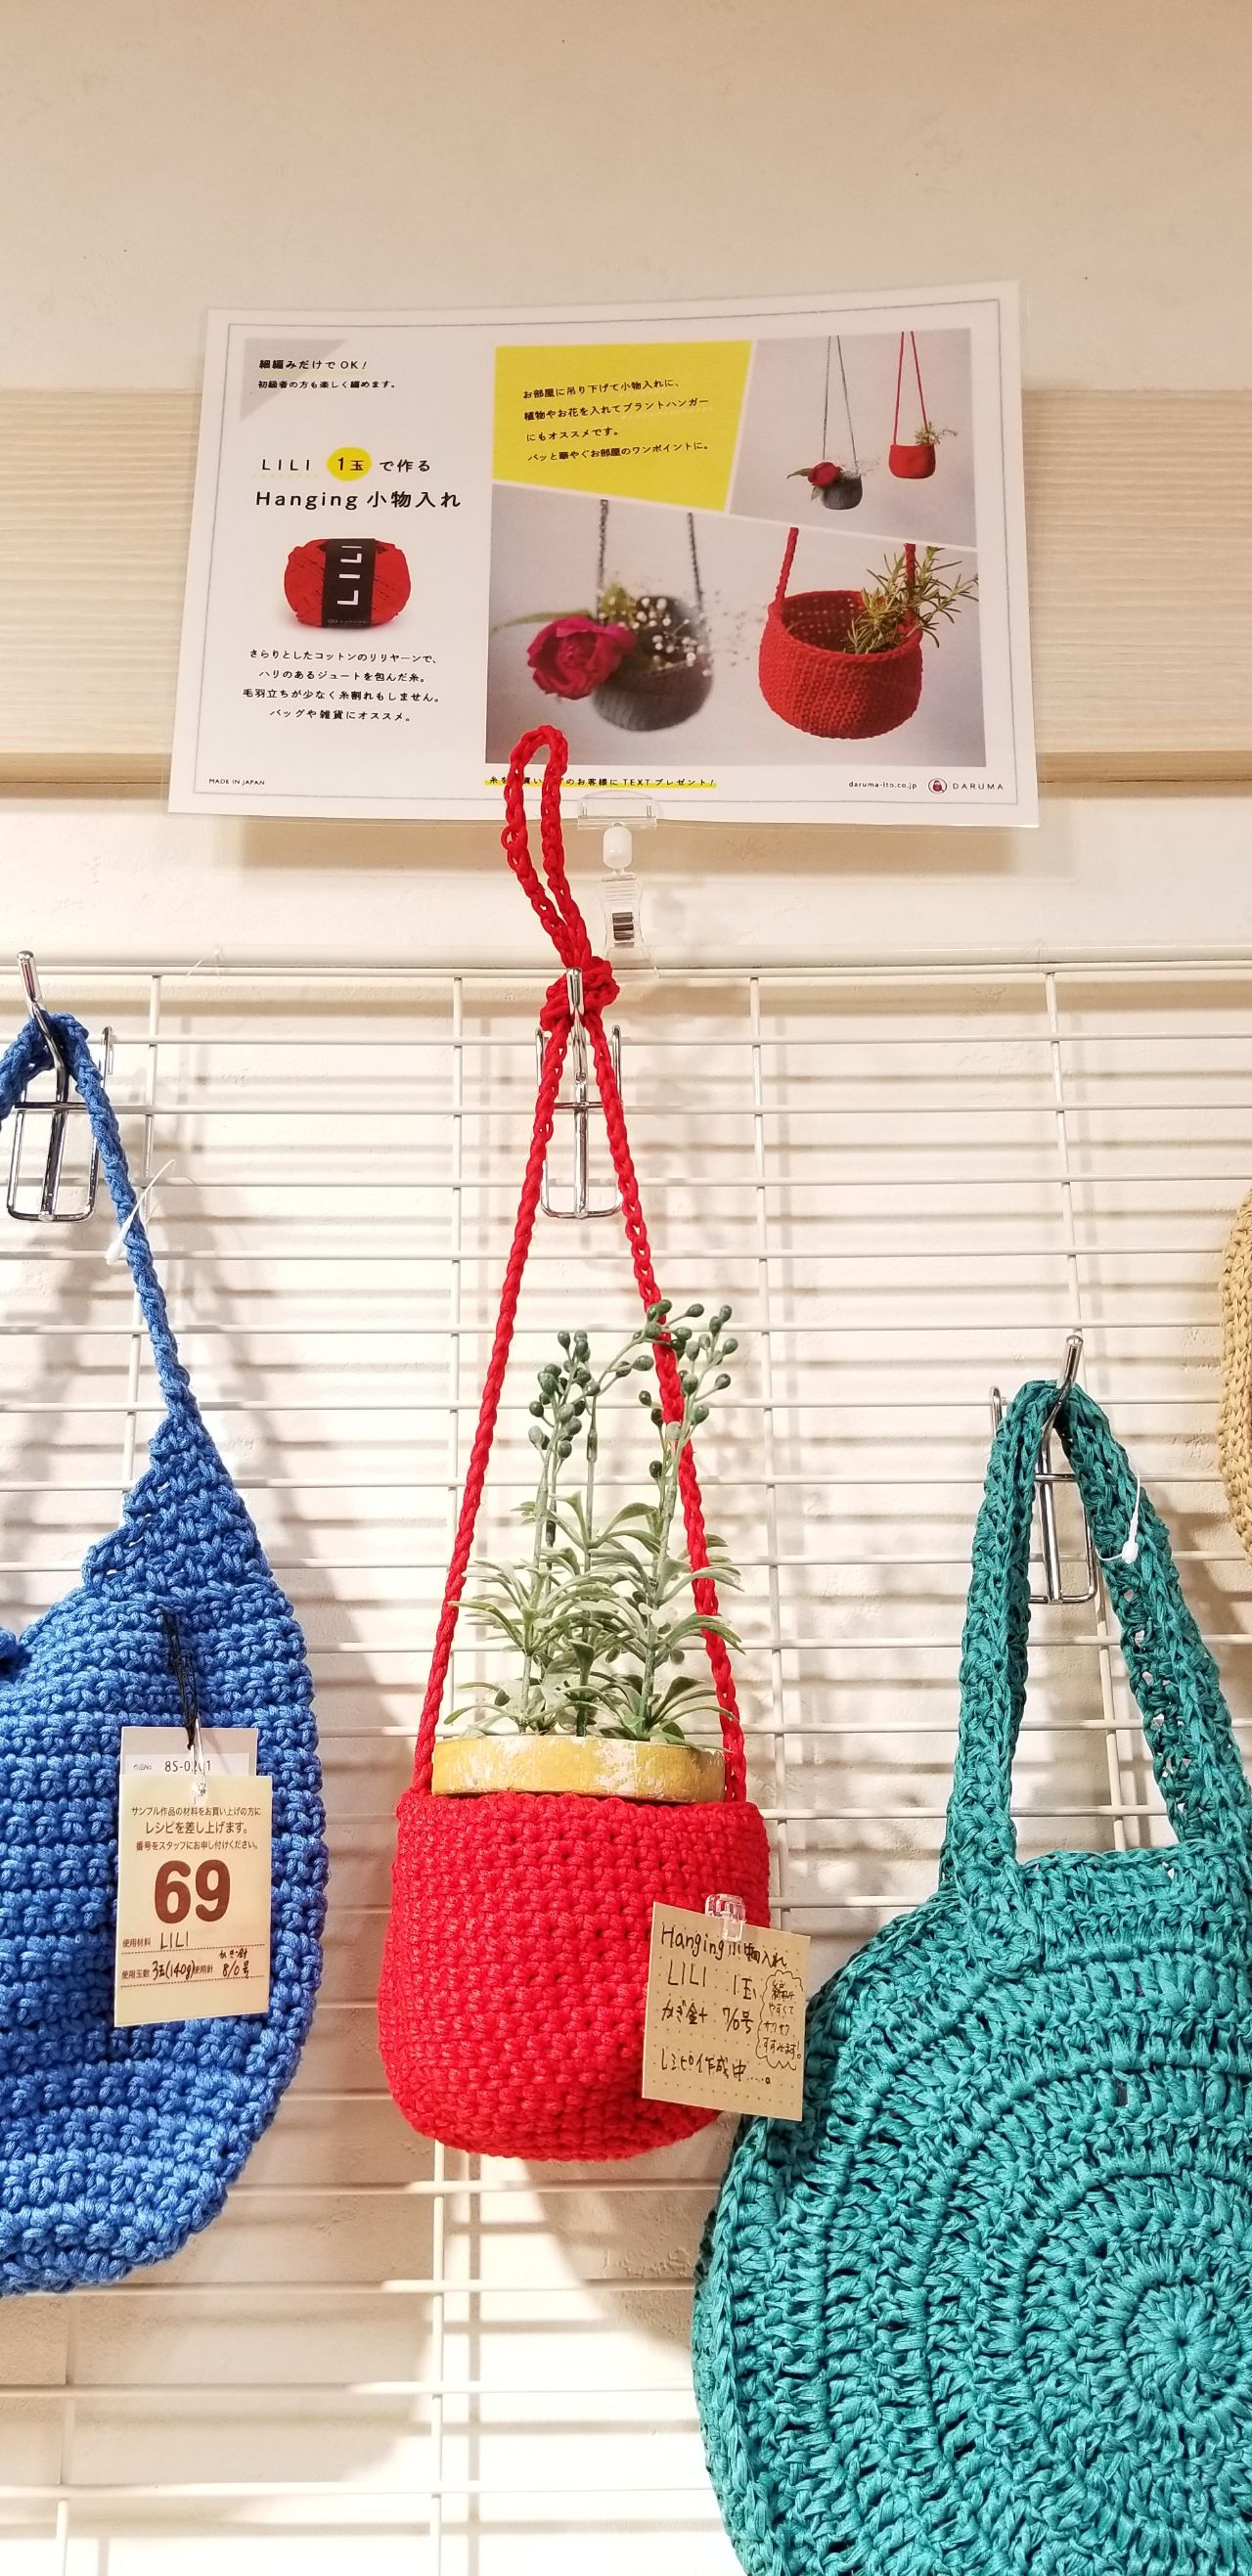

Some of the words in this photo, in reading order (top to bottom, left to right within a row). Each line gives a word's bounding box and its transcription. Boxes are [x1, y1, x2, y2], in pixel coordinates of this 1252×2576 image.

[339, 360, 368, 370] OK!
[526, 426, 619, 442] にもオススメです。
[261, 459, 311, 472] LILI
[336, 457, 365, 472] 1玉
[379, 459, 431, 473] で作る
[255, 491, 359, 511] Hanging
[366, 491, 462, 509] 小物入れ
[336, 545, 362, 606] LILI
[258, 670, 425, 683] ハリのあるジュートを包んだ糸。
[622, 778, 650, 787] TEXT
[848, 780, 917, 790] daruma-ito.co.jp
[952, 782, 1005, 791] DARUMA
[146, 1821, 247, 1834] レシピを差し上げます。
[155, 1859, 231, 1924] 69
[122, 1938, 152, 1948] 使用材料
[160, 1930, 189, 1949] LILI
[661, 1923, 725, 1961] Hanging
[667, 1959, 706, 1987] LILI
